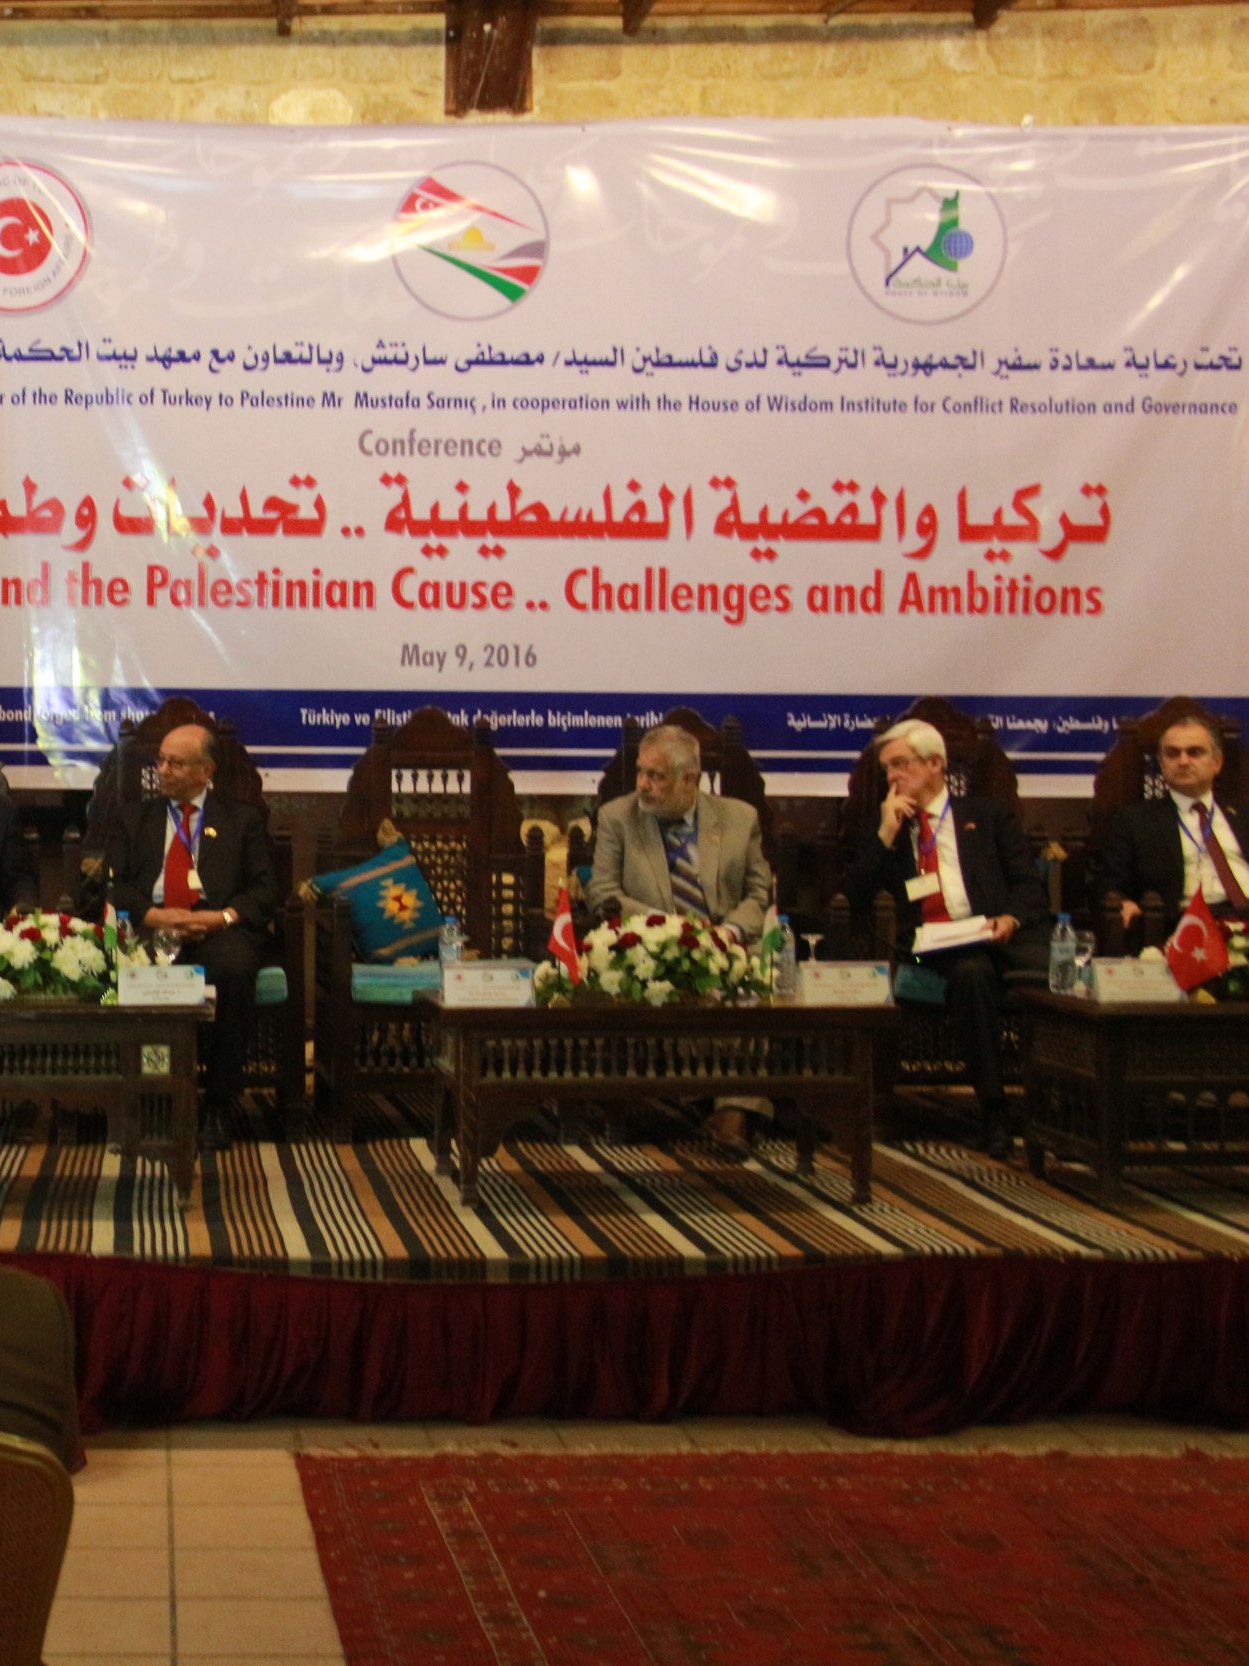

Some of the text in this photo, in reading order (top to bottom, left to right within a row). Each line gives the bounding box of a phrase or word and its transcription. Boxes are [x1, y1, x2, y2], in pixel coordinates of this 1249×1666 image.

[96, 337, 138, 370] بيت
[145, 344, 201, 371] معهد
[208, 348, 236, 375] مع
[242, 341, 344, 373] وبالتعاون
[454, 342, 545, 375] مصطفى
[631, 345, 719, 377] فلسطين
[725, 346, 768, 374] لدى
[776, 344, 866, 377] التركية
[873, 345, 985, 379] الجمهورية
[991, 347, 1042, 380] سفير
[1049, 347, 1116, 372] سعادة
[1124, 346, 1189, 378] رعاية
[1193, 345, 1243, 372] تحت
[11, 387, 26, 406] of
[32, 386, 58, 406] the
[64, 386, 133, 410] Republic
[139, 387, 155, 406] of
[161, 388, 212, 412] Turkey
[218, 389, 234, 408] to
[240, 389, 315, 409] Palestine
[354, 390, 421, 410] Mustafa
[491, 392, 506, 410] in
[512, 392, 610, 415] cooperation
[616, 392, 651, 411] with
[656, 393, 682, 413] the
[688, 394, 739, 413] House
[745, 393, 761, 413] of
[767, 394, 833, 413] Wisdom
[840, 395, 908, 414] Institute
[913, 395, 936, 414] for
[942, 395, 1003, 414] Conflict
[1010, 396, 1097, 415] Resolution
[1103, 396, 1135, 414] and
[1141, 395, 1238, 415] Governance
[357, 428, 503, 459] Conference
[515, 433, 582, 463] مؤتمر
[112, 474, 327, 560] تحديات
[379, 471, 694, 561] الفلسطينية
[708, 475, 938, 563] والقضية
[957, 480, 1111, 563] تركيا
[66, 560, 131, 608] the
[146, 560, 376, 611] Palestinian
[564, 565, 793, 624] Challenges
[806, 568, 884, 615] and
[898, 569, 1103, 617] Ambitions
[401, 643, 538, 674] May 9, 2016
[300, 707, 350, 729] Türkiye
[354, 712, 370, 726] ve
[548, 709, 623, 732] biçimlenen
